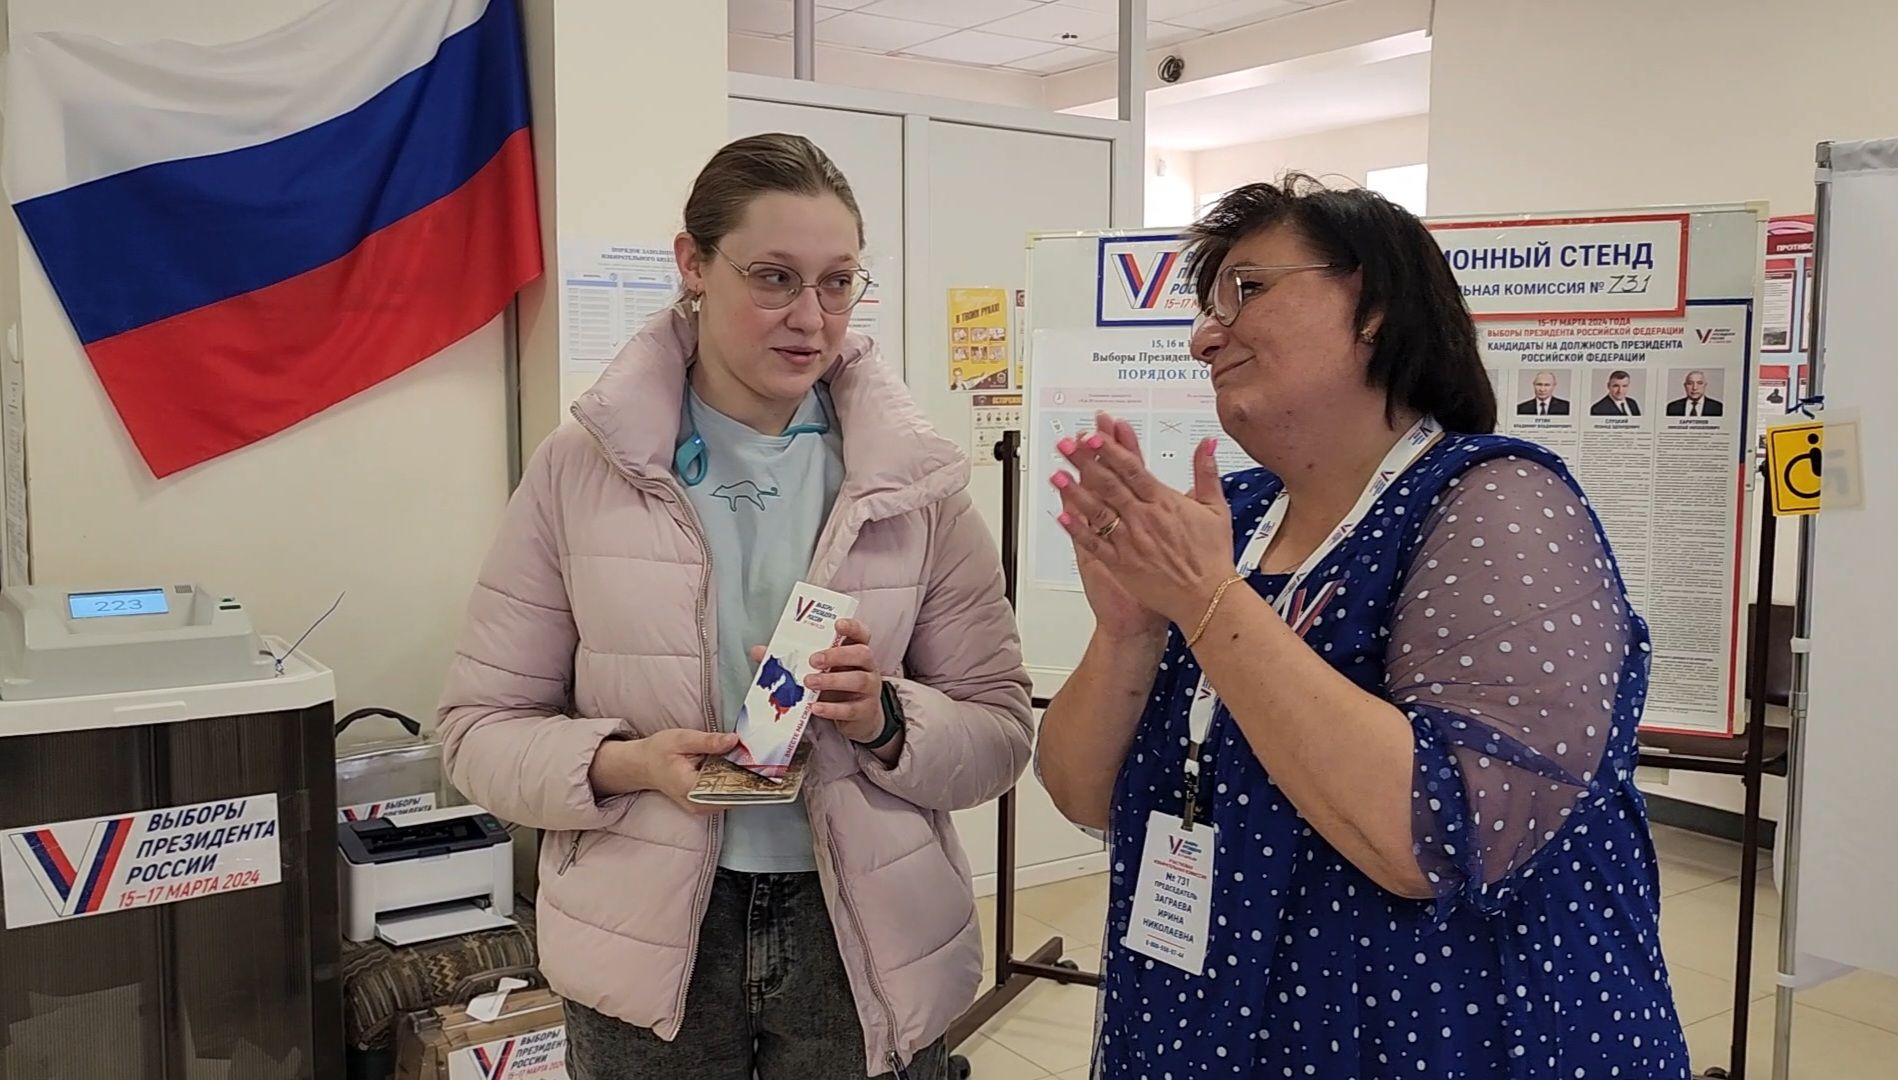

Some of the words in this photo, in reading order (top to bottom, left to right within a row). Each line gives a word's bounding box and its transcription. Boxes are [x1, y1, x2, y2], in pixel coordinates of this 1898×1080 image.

[1560, 243, 1654, 269] СТЕНД
[1504, 282, 1586, 296] КОМИССИЯ
[1588, 318, 1608, 326] 2024
[1609, 317, 1631, 325] ГОДА
[1487, 329, 1522, 337] ВЫБОРЫ
[1524, 328, 1575, 337] ПРЕЗИДЕНТА
[1577, 326, 1630, 336] РОССИЙСКОЙ
[1632, 327, 1684, 336] ФЕДЕРАЦИИ
[1167, 340, 1176, 348] 16
[1487, 342, 1544, 351] КАНДИДАТЫ
[1546, 342, 1559, 350] НА
[1560, 341, 1619, 351] ДОЛЖНОСТЬ
[1621, 340, 1683, 350] ПРЕЗИДЕНТА
[1092, 352, 1136, 362] Выборы
[1521, 352, 1584, 362] РОССИЙСКОЙ
[1586, 353, 1646, 362] ФЕДЕРАЦИИ
[1118, 369, 1187, 380] ПОРЯДОК
[95, 599, 142, 611] 223
[385, 797, 421, 809] ВЫБОРЫ
[147, 800, 247, 832] ВЫБОРЫ
[136, 819, 276, 859] ПРЕЗИДЕНТА
[125, 853, 218, 885] РОССИИ
[165, 876, 219, 900] МАРТА
[222, 869, 260, 889] 2024
[1177, 875, 1190, 887] 731
[1154, 880, 1198, 900] ПРЕДСЕДАТЕЛЬ
[1155, 893, 1192, 912] ЗАГРАЕВА
[1158, 908, 1184, 924] ИРИНА
[1143, 918, 1194, 943] НИКОЛАЕВНА
[520, 1029, 561, 1046] ВЫБОРЫ
[510, 1054, 548, 1070] РОССИИ
